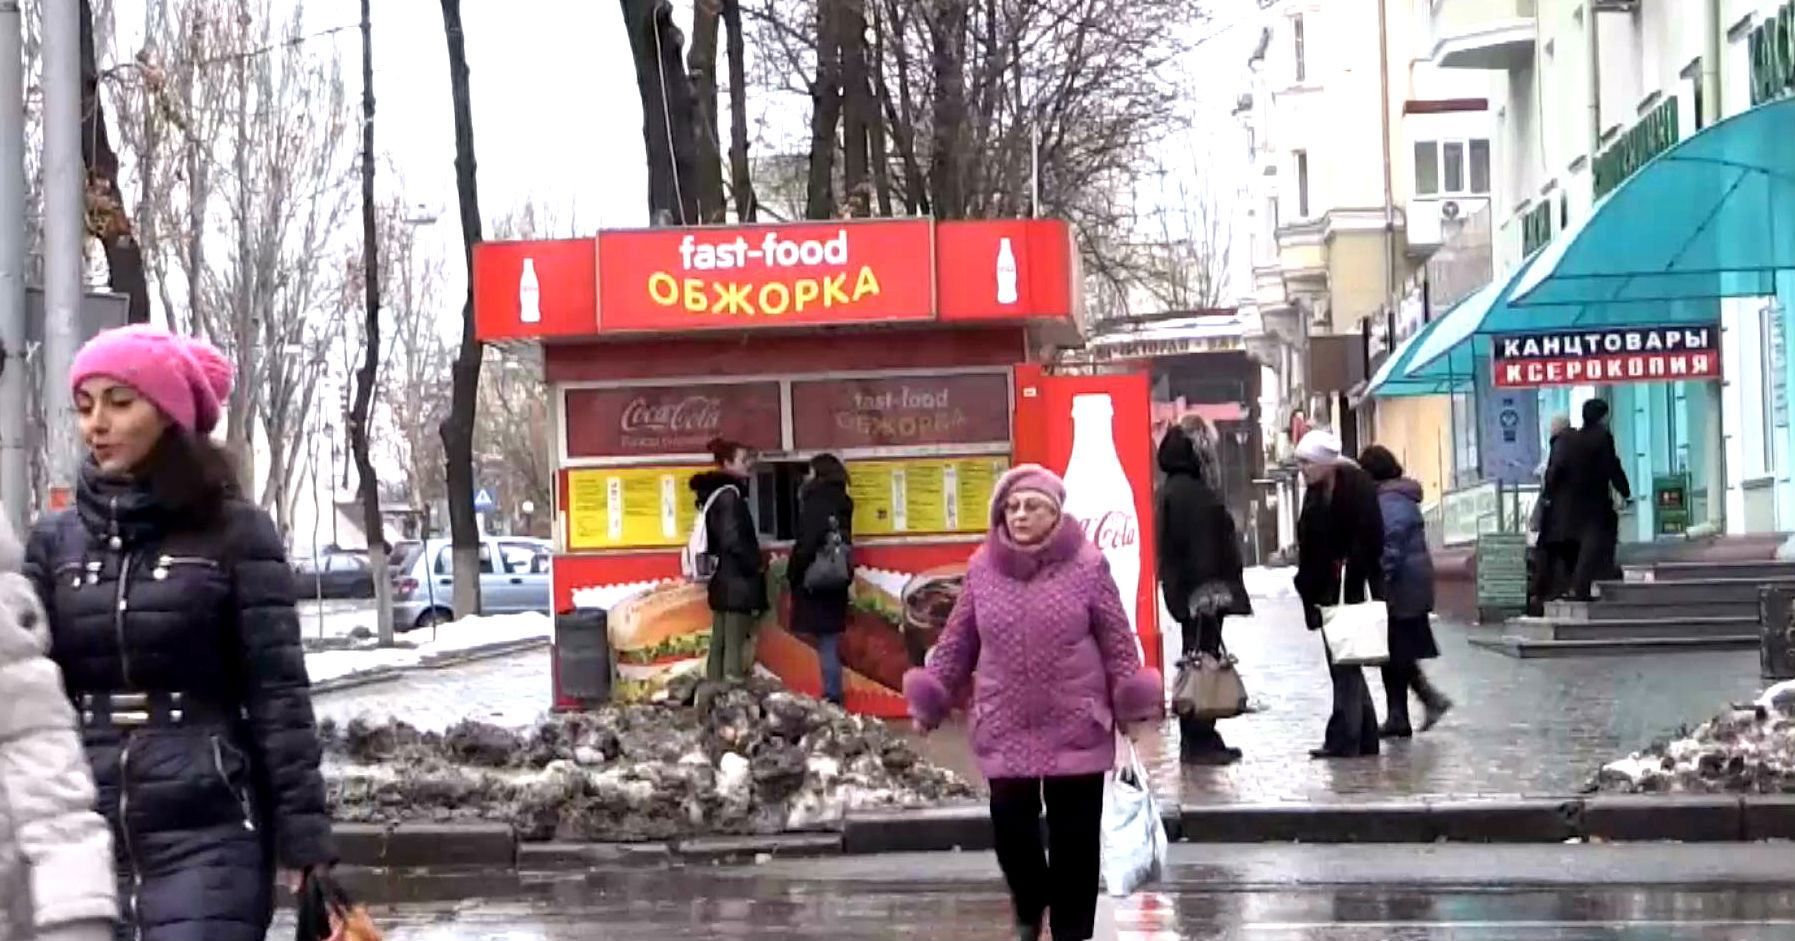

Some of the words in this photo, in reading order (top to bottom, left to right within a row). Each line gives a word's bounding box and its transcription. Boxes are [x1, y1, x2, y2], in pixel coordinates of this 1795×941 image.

[679, 229, 847, 270] fast-food
[648, 265, 880, 315] ОБЖОРКА
[1504, 328, 1708, 358] КАНЦТОВАРЫ
[1506, 354, 1709, 383] КСЕРОКОПИЯ
